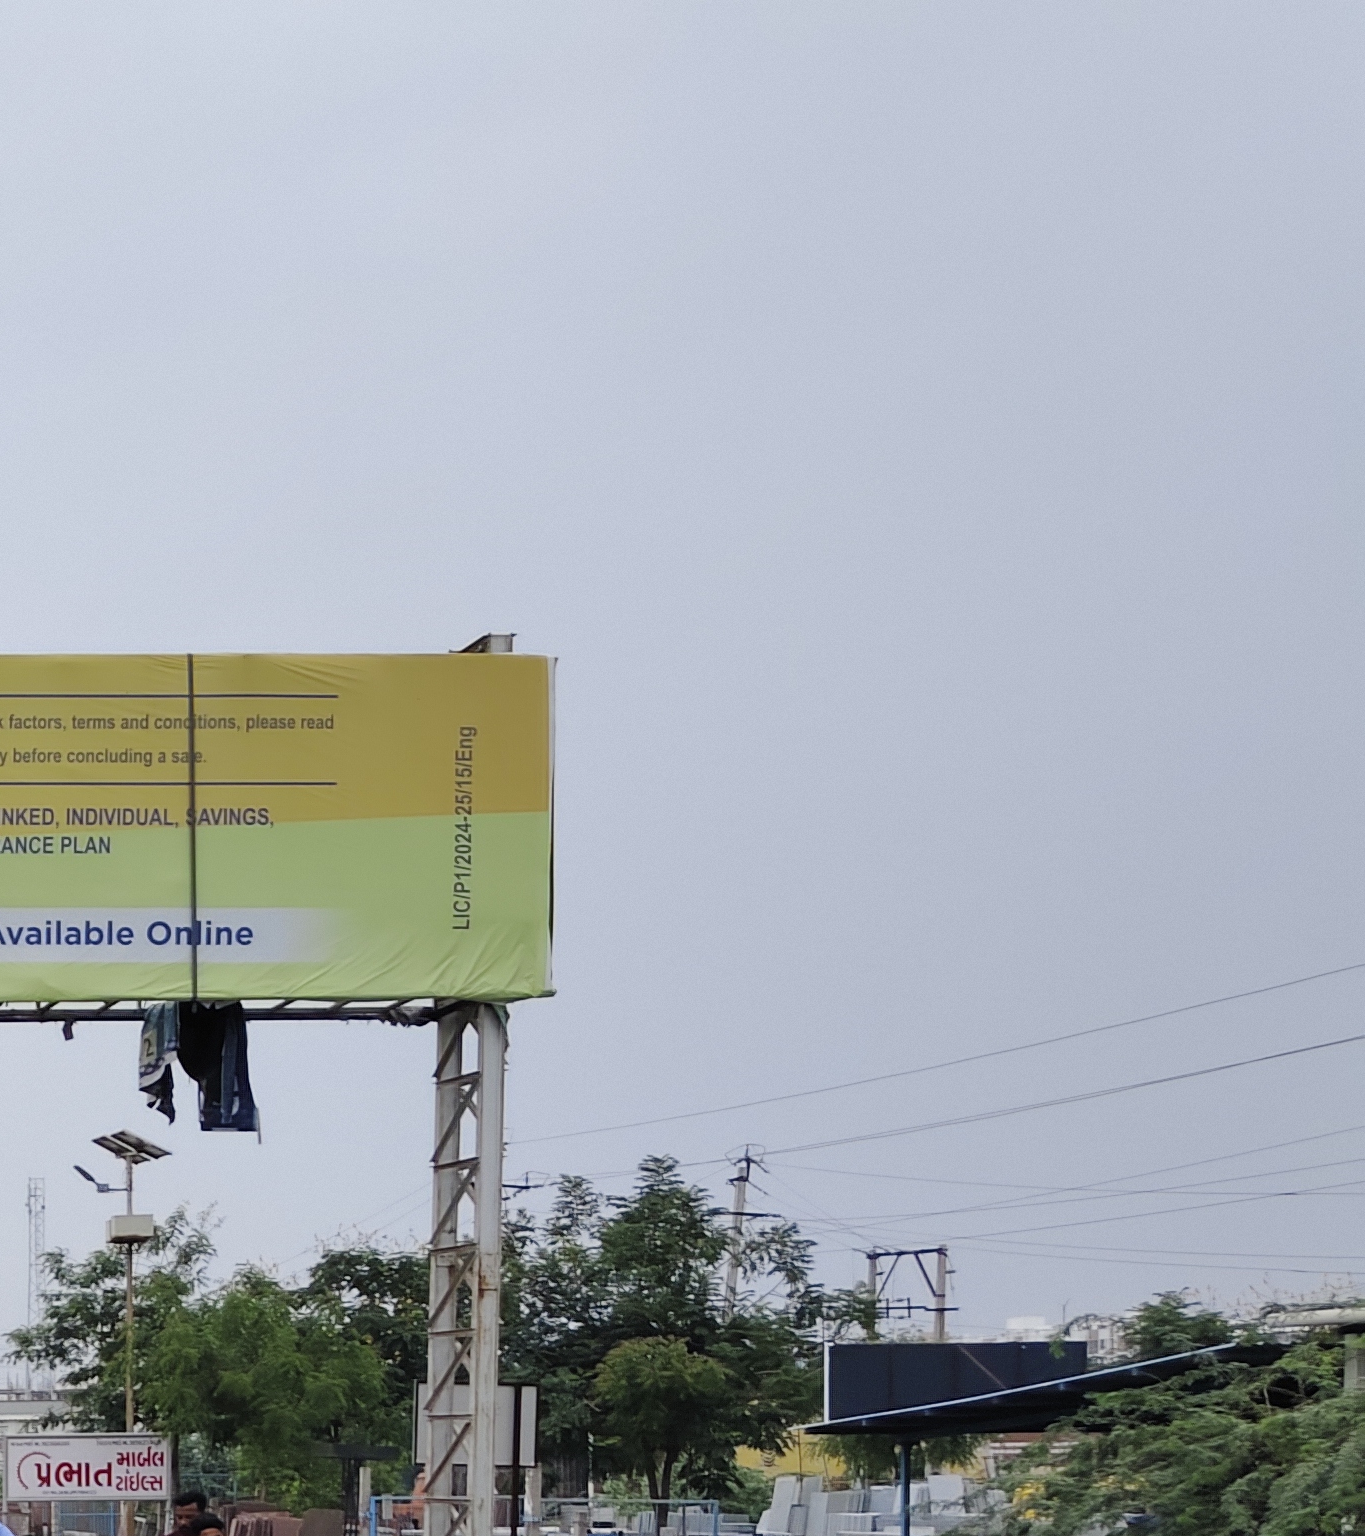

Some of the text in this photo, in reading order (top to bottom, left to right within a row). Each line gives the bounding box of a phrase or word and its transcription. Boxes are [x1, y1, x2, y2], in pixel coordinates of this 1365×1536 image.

[9, 713, 67, 732] factors,
[72, 714, 115, 730] terms
[120, 714, 149, 730] and
[245, 714, 296, 733] please
[300, 714, 334, 730] read
[12, 748, 62, 763] before
[66, 749, 152, 767] concluding
[157, 752, 167, 763] a
[171, 750, 207, 764] sae.
[66, 808, 179, 828] INDIVIDUAL,
[185, 807, 274, 829] SAVINGS,
[452, 726, 478, 930] LIC/P1/2024-25/15/Eng
[60, 836, 111, 854] PLAN
[146, 920, 254, 946] Online
[116, 1446, 164, 1467] માર્બલ
[34, 1461, 113, 1488] પ્રભાત
